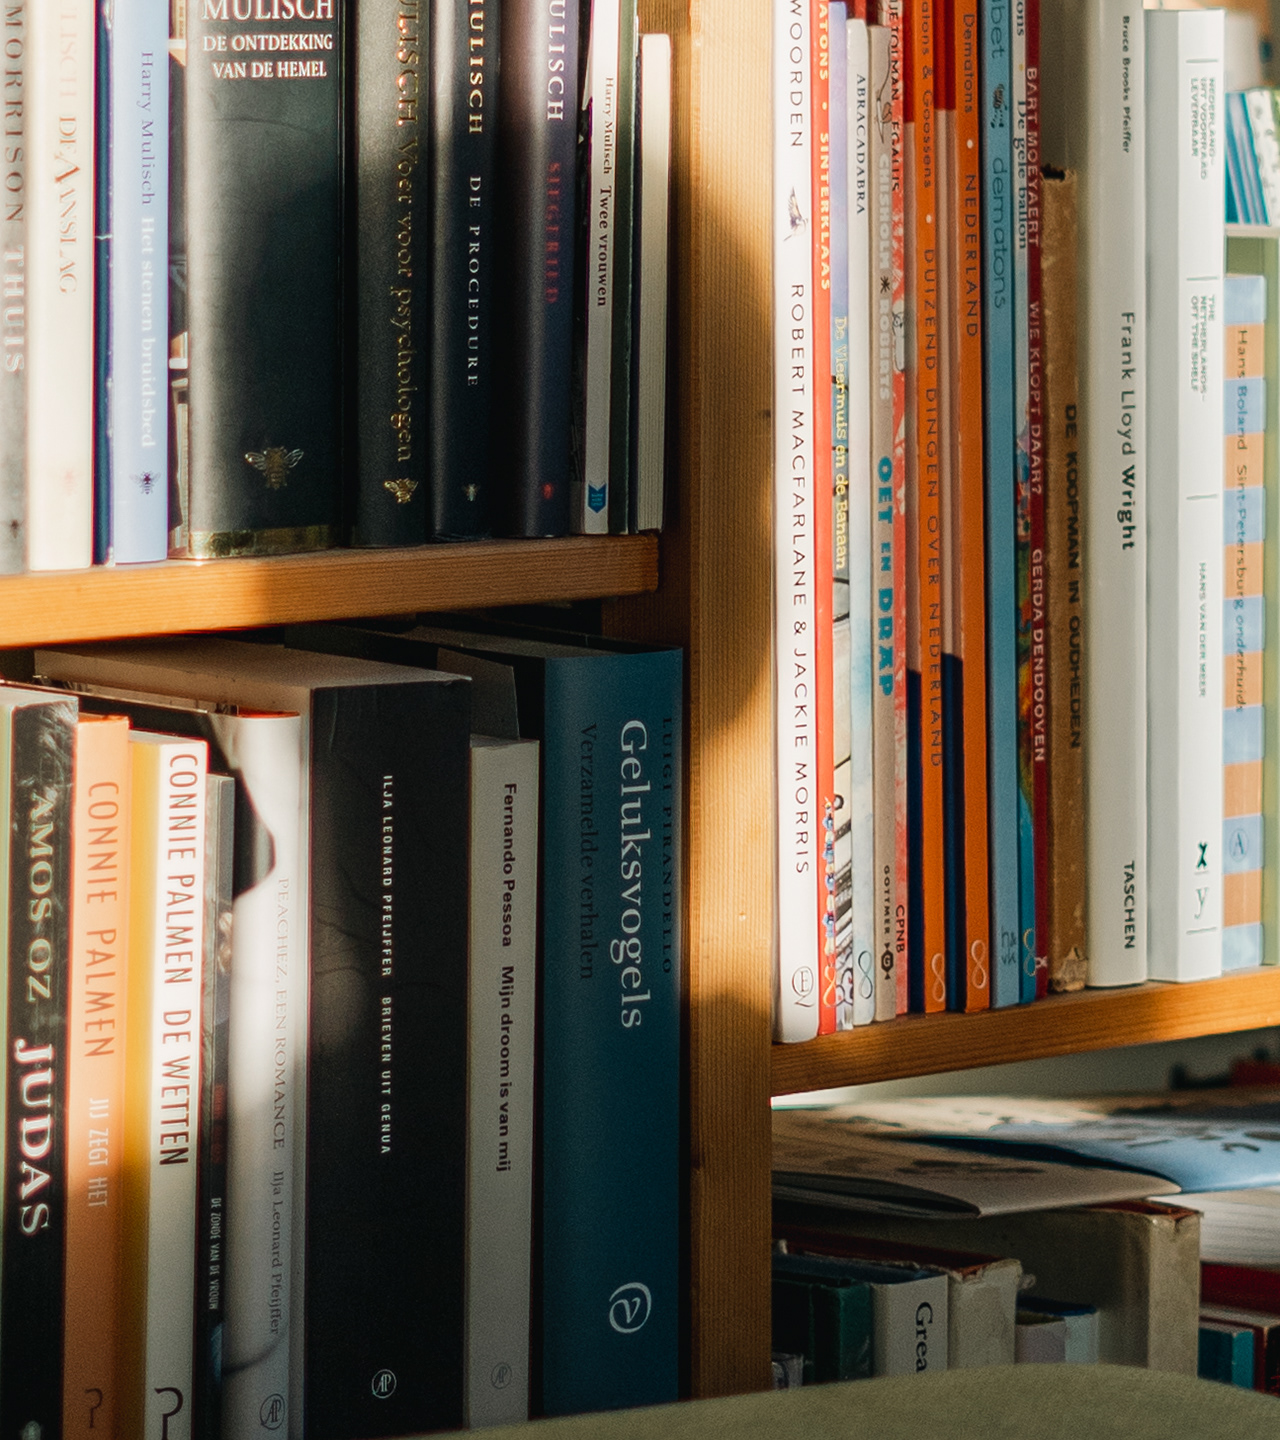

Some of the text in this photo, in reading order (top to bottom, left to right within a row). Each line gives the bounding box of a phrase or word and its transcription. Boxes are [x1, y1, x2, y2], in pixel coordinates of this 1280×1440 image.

[202, 33, 334, 53] DE ONTDEKKING
[211, 59, 328, 79] VAN DE HEMEL
[1118, 311, 1137, 552] Frank Lloyd Wright
[17, 789, 54, 1237] AMOS OZ JUDAS
[157, 752, 199, 1168] CONNIE PALMEN DE WETTEN
[496, 783, 517, 1173] Fernando Pessoa Mijn droom is van mij
[609, 719, 651, 1031] Geluksvogels
[1123, 859, 1136, 950] TASCHEN
